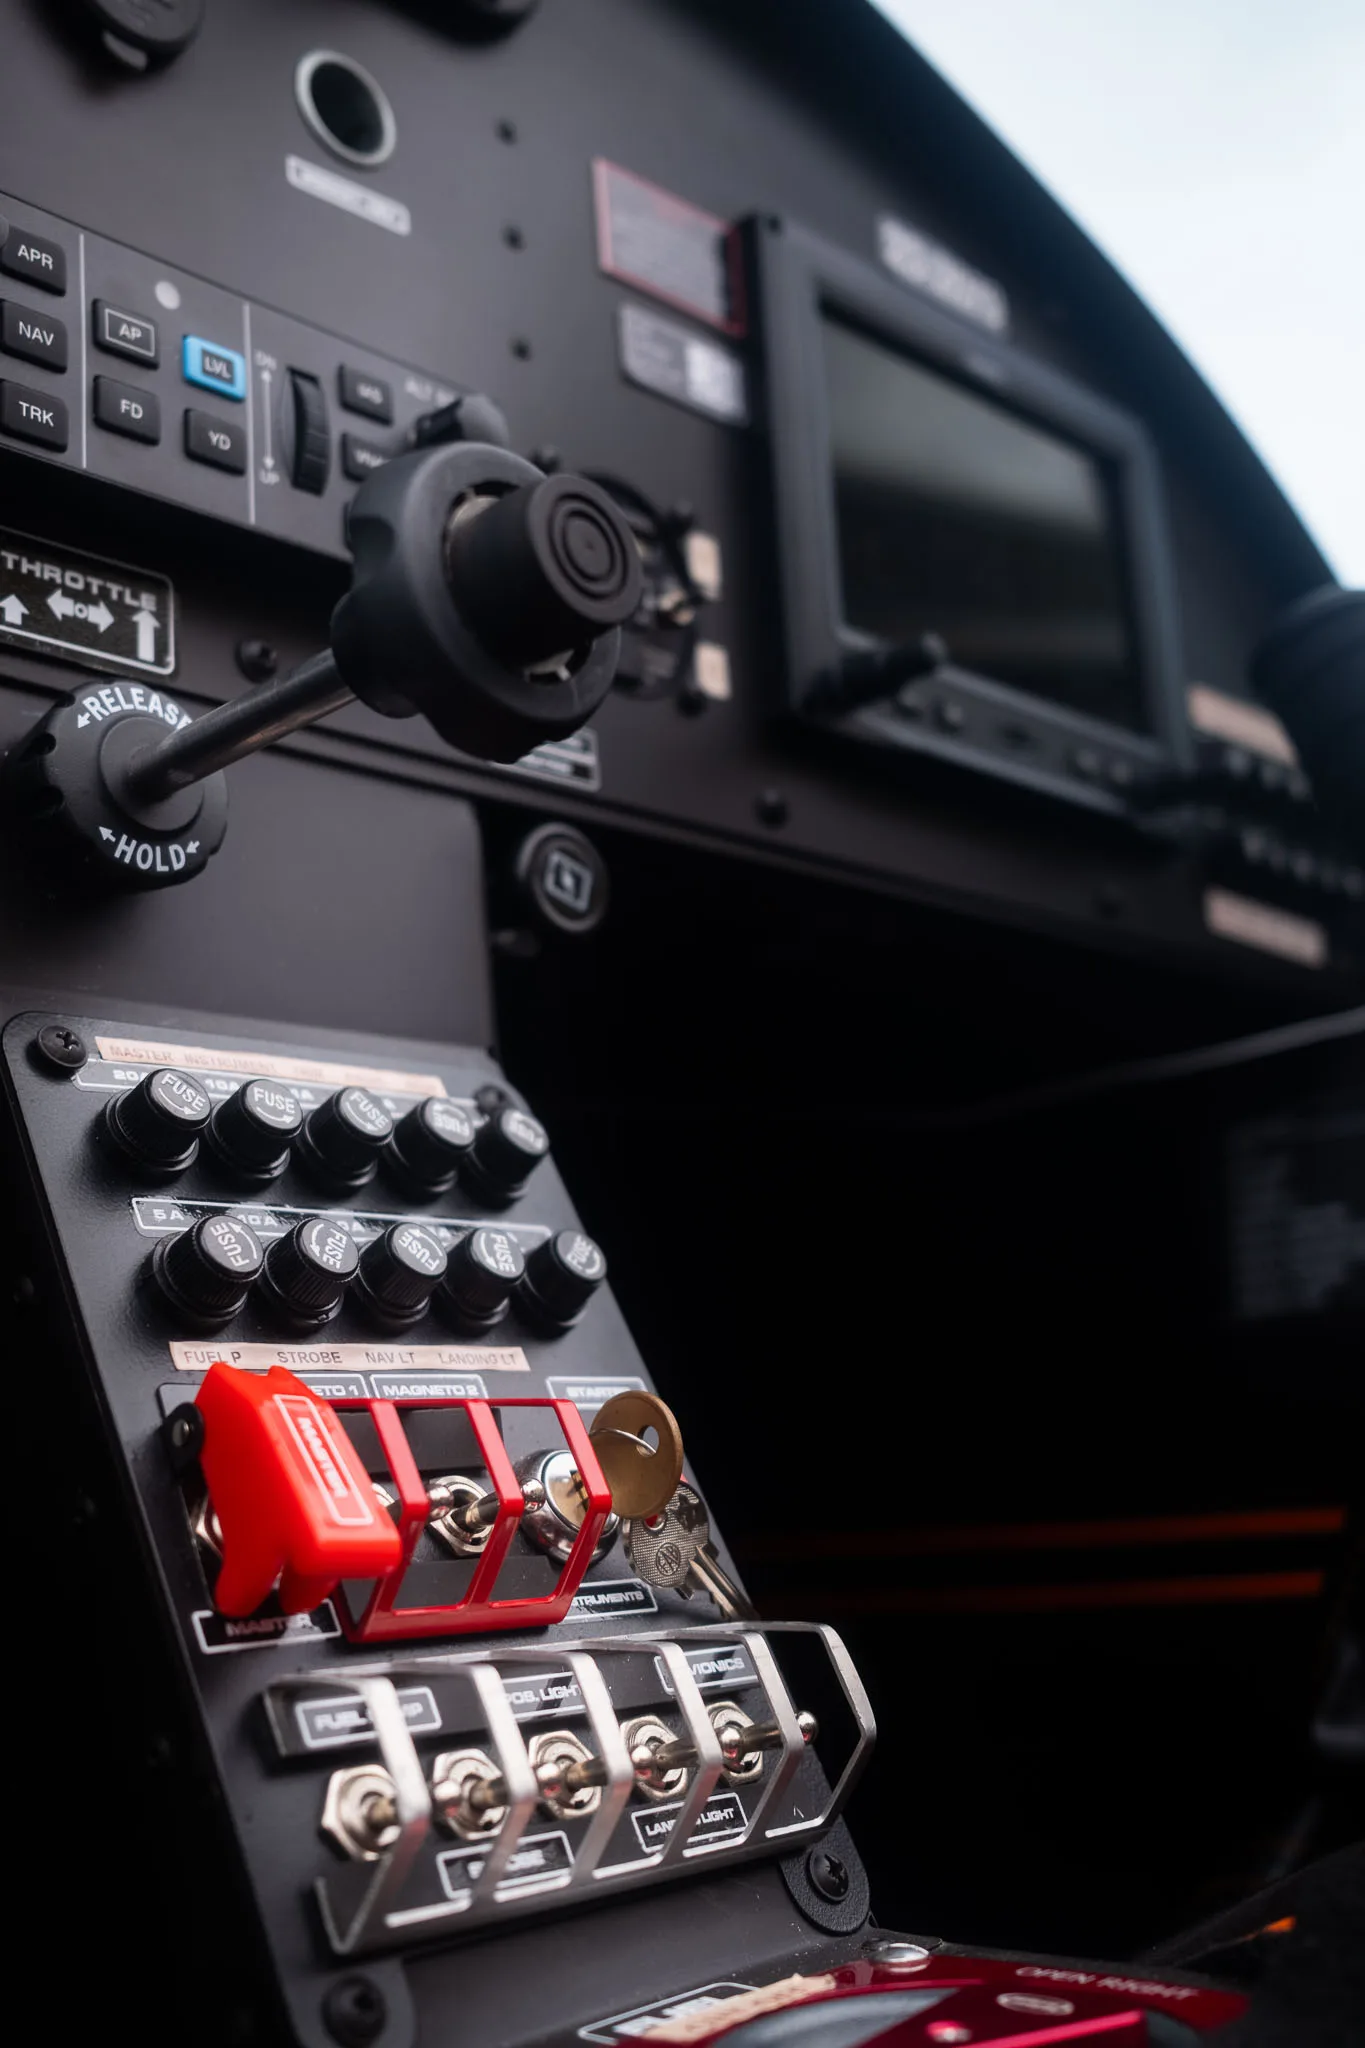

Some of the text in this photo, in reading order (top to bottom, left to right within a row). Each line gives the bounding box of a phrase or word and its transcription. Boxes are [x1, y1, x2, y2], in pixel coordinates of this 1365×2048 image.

[17, 244, 54, 270] APR
[18, 320, 54, 346] NAV
[118, 323, 142, 341] AP
[203, 355, 232, 379] LVL
[18, 400, 55, 427] TRK
[120, 399, 144, 419] FD
[208, 430, 232, 450] YD
[0, 550, 158, 612] THROTTLE
[114, 834, 187, 872] HOLD
[109, 1045, 174, 1062] MASTER
[161, 1073, 206, 1111] FUSE
[253, 1087, 296, 1115] FUSE
[350, 1091, 389, 1129] FUSE
[209, 1222, 250, 1268] FUSE
[322, 1228, 347, 1269] FUSE
[398, 1230, 441, 1272] FUSE
[490, 1232, 517, 1274] FUSE
[184, 1351, 517, 1365] FUEL P STROBE NAV LT LANDING LT
[382, 1384, 480, 1397] MAGNETO 2
[571, 1591, 645, 1606] STRUMENTS
[689, 1657, 745, 1675] VIONICS
[700, 1808, 735, 1824] LIGHT
[1015, 1966, 1200, 2000] OPEN RIGHT
